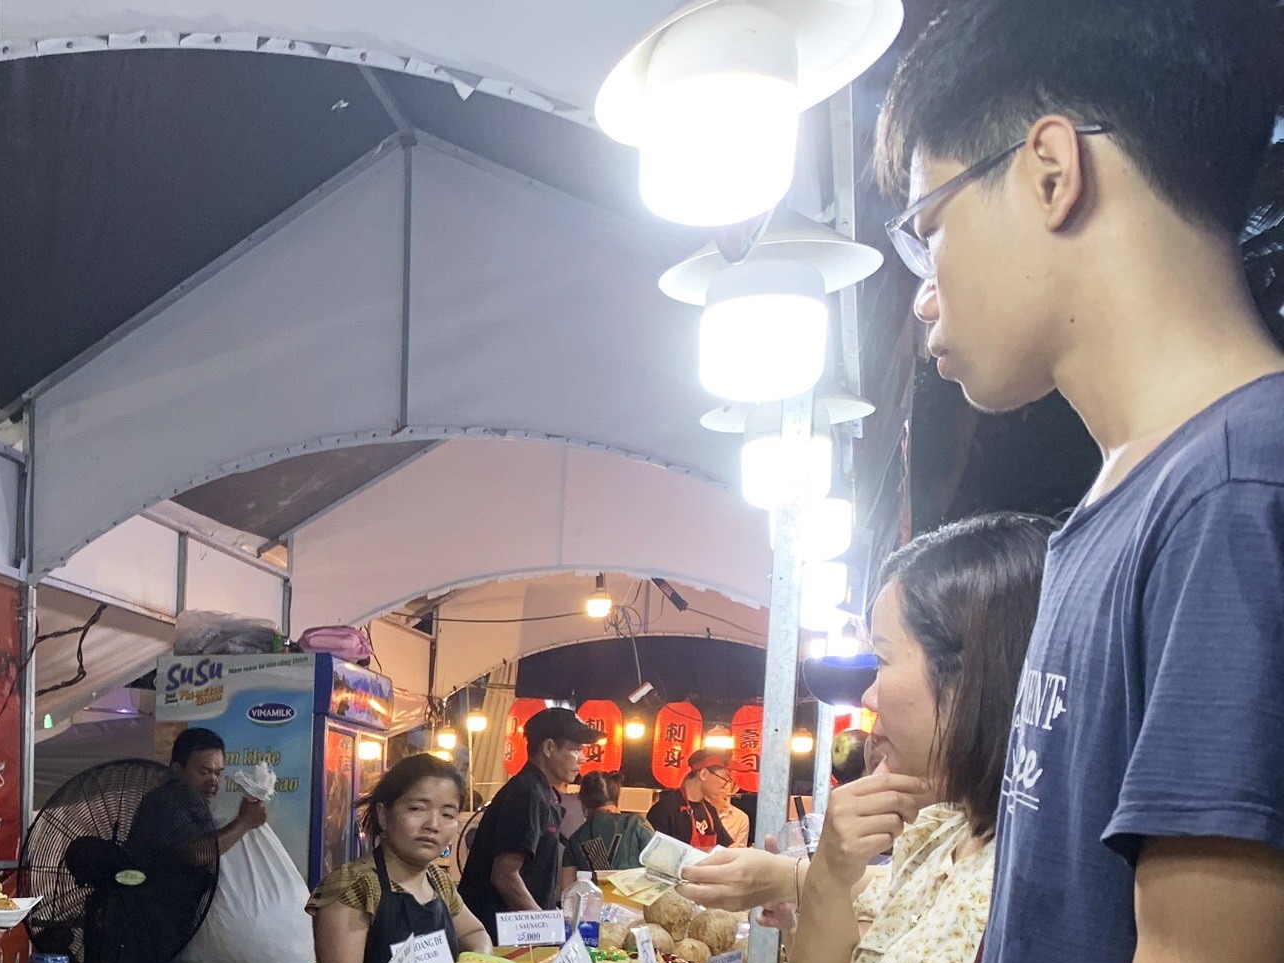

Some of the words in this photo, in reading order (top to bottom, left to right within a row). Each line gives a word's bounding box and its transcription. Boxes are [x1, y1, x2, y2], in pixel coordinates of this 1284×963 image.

[165, 658, 223, 691] SuSu
[250, 708, 292, 717] VINAMILK
[664, 721, 686, 769] 刺身
[517, 932, 541, 942] 25.000
